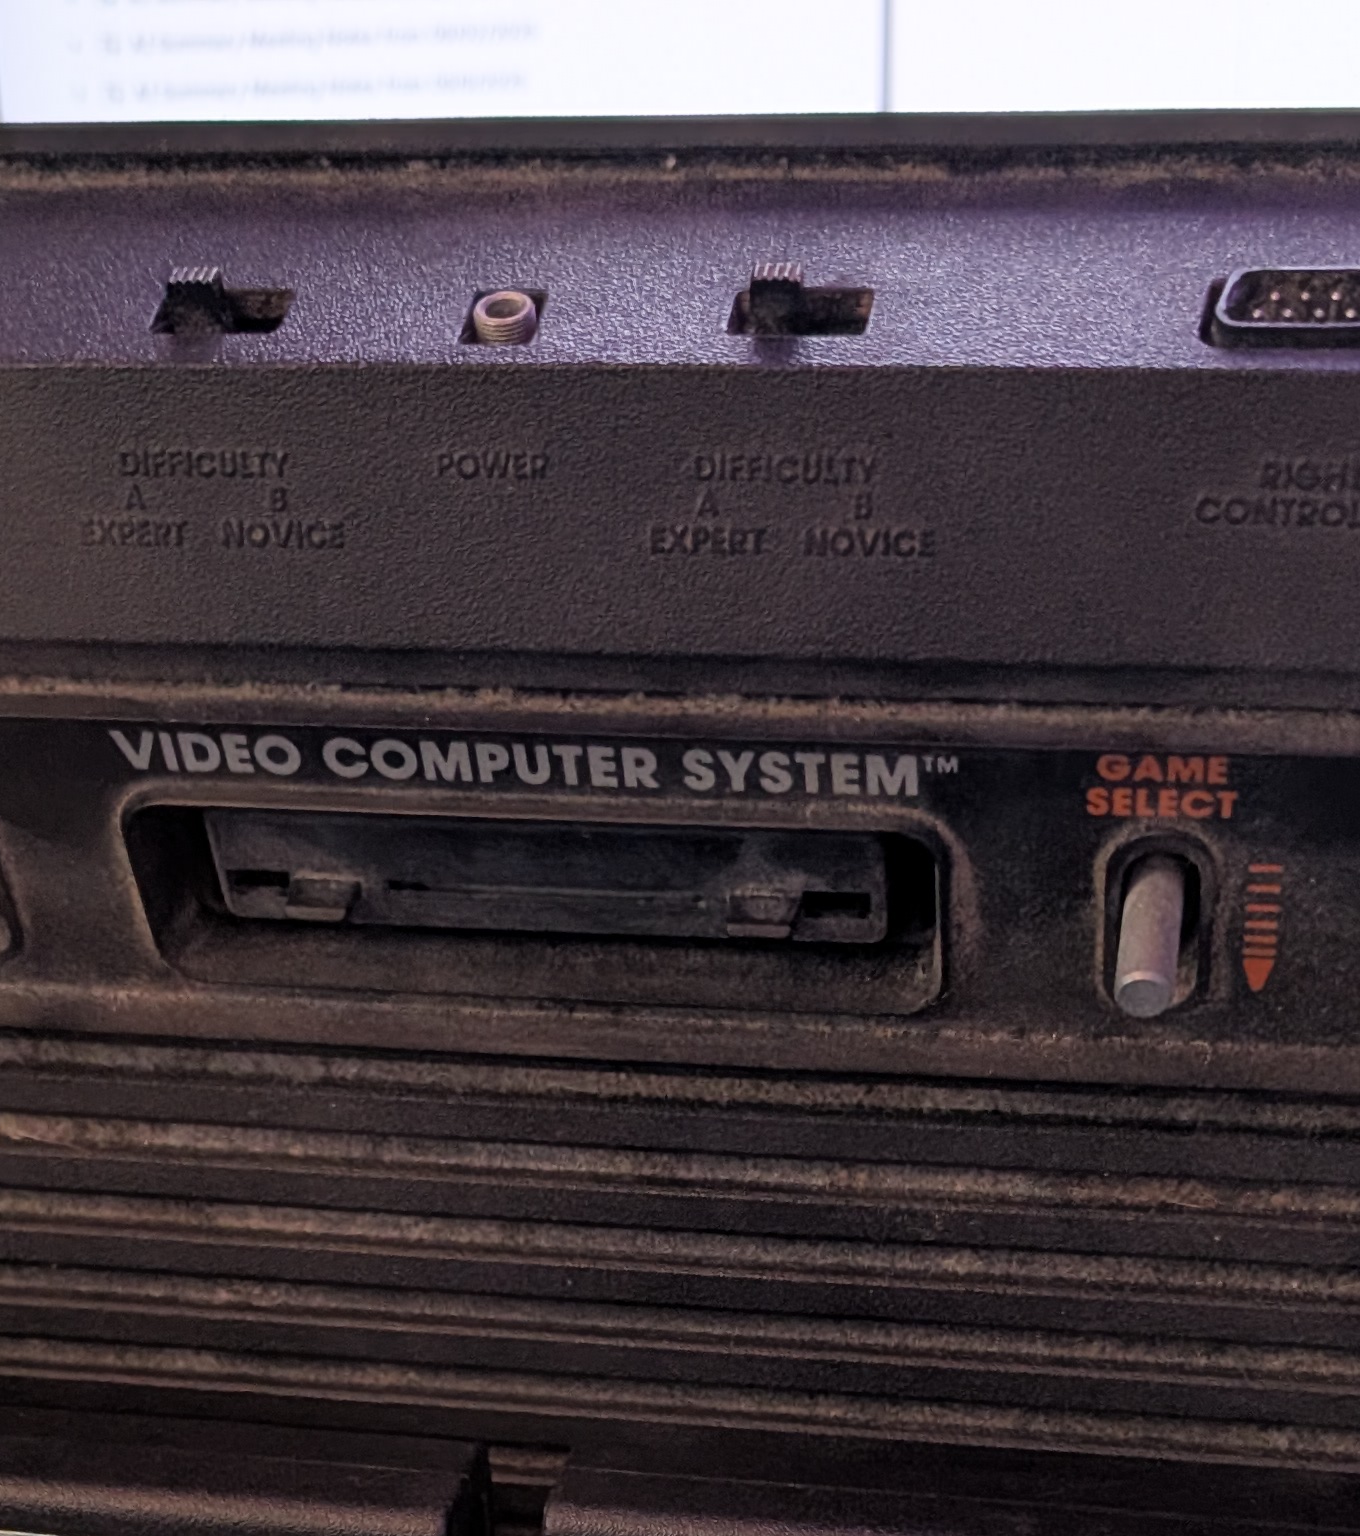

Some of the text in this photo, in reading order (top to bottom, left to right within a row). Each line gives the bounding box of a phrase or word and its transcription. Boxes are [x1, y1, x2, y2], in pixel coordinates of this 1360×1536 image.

[118, 450, 291, 479] DIFFICULTY
[439, 452, 550, 481] POWER
[694, 453, 879, 485] DIFFICULTY
[126, 484, 289, 513] A B
[696, 493, 874, 521] A B
[81, 519, 345, 550] EXPERT NOVICE
[649, 525, 937, 559] EXPERT NOVICE
[110, 729, 302, 777] VIDEO
[322, 736, 660, 790] COMPUTER
[1095, 754, 1229, 785] GAME
[1085, 786, 1238, 820] SELECT
